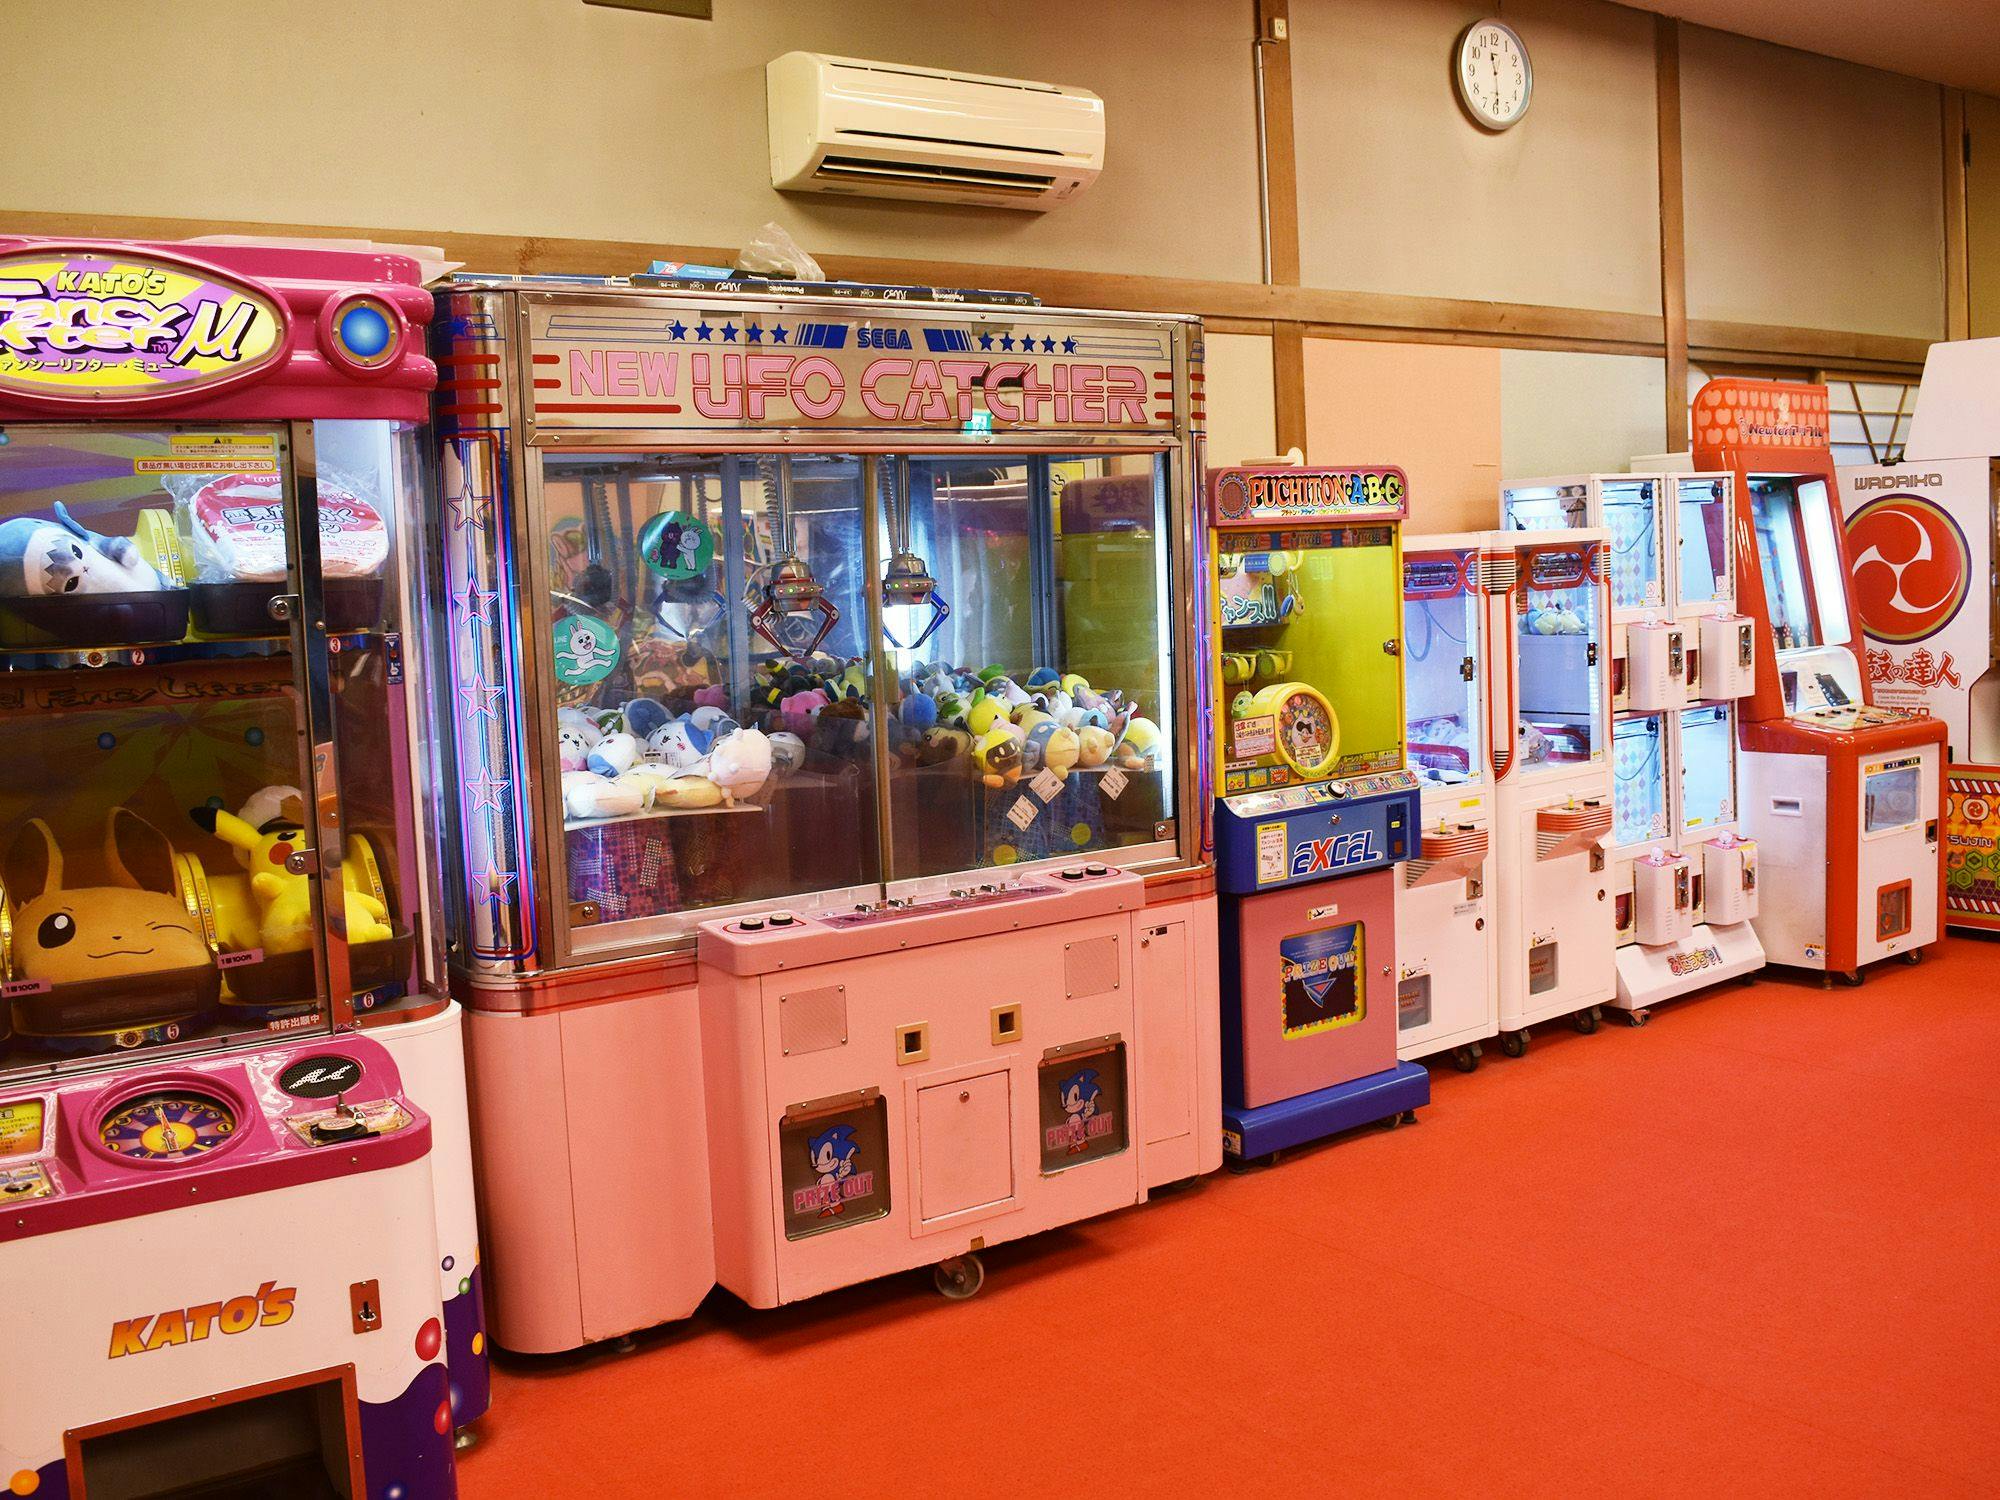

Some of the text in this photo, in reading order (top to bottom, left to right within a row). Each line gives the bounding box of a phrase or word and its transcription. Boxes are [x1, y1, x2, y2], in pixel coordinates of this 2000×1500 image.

[56, 268, 167, 295] KATO'S
[769, 285, 804, 295] Panasonic
[857, 327, 913, 350] SEGA
[0, 358, 175, 374] ァンシーリフター・ミュー
[569, 349, 1148, 424] NEW UFO CATCHER
[1248, 474, 1347, 508] PUCHITON
[1854, 473, 1943, 491] WADAIKO
[1221, 584, 1277, 623] ャンス!!
[1291, 830, 1378, 877] EXCEL
[1947, 834, 1993, 848] SUJIN
[269, 1013, 321, 1031] 特許出願中
[1046, 1114, 1114, 1148] PRIZE OUT
[793, 1173, 874, 1213] PRIZE OUT
[107, 1280, 298, 1360] KATO'S
